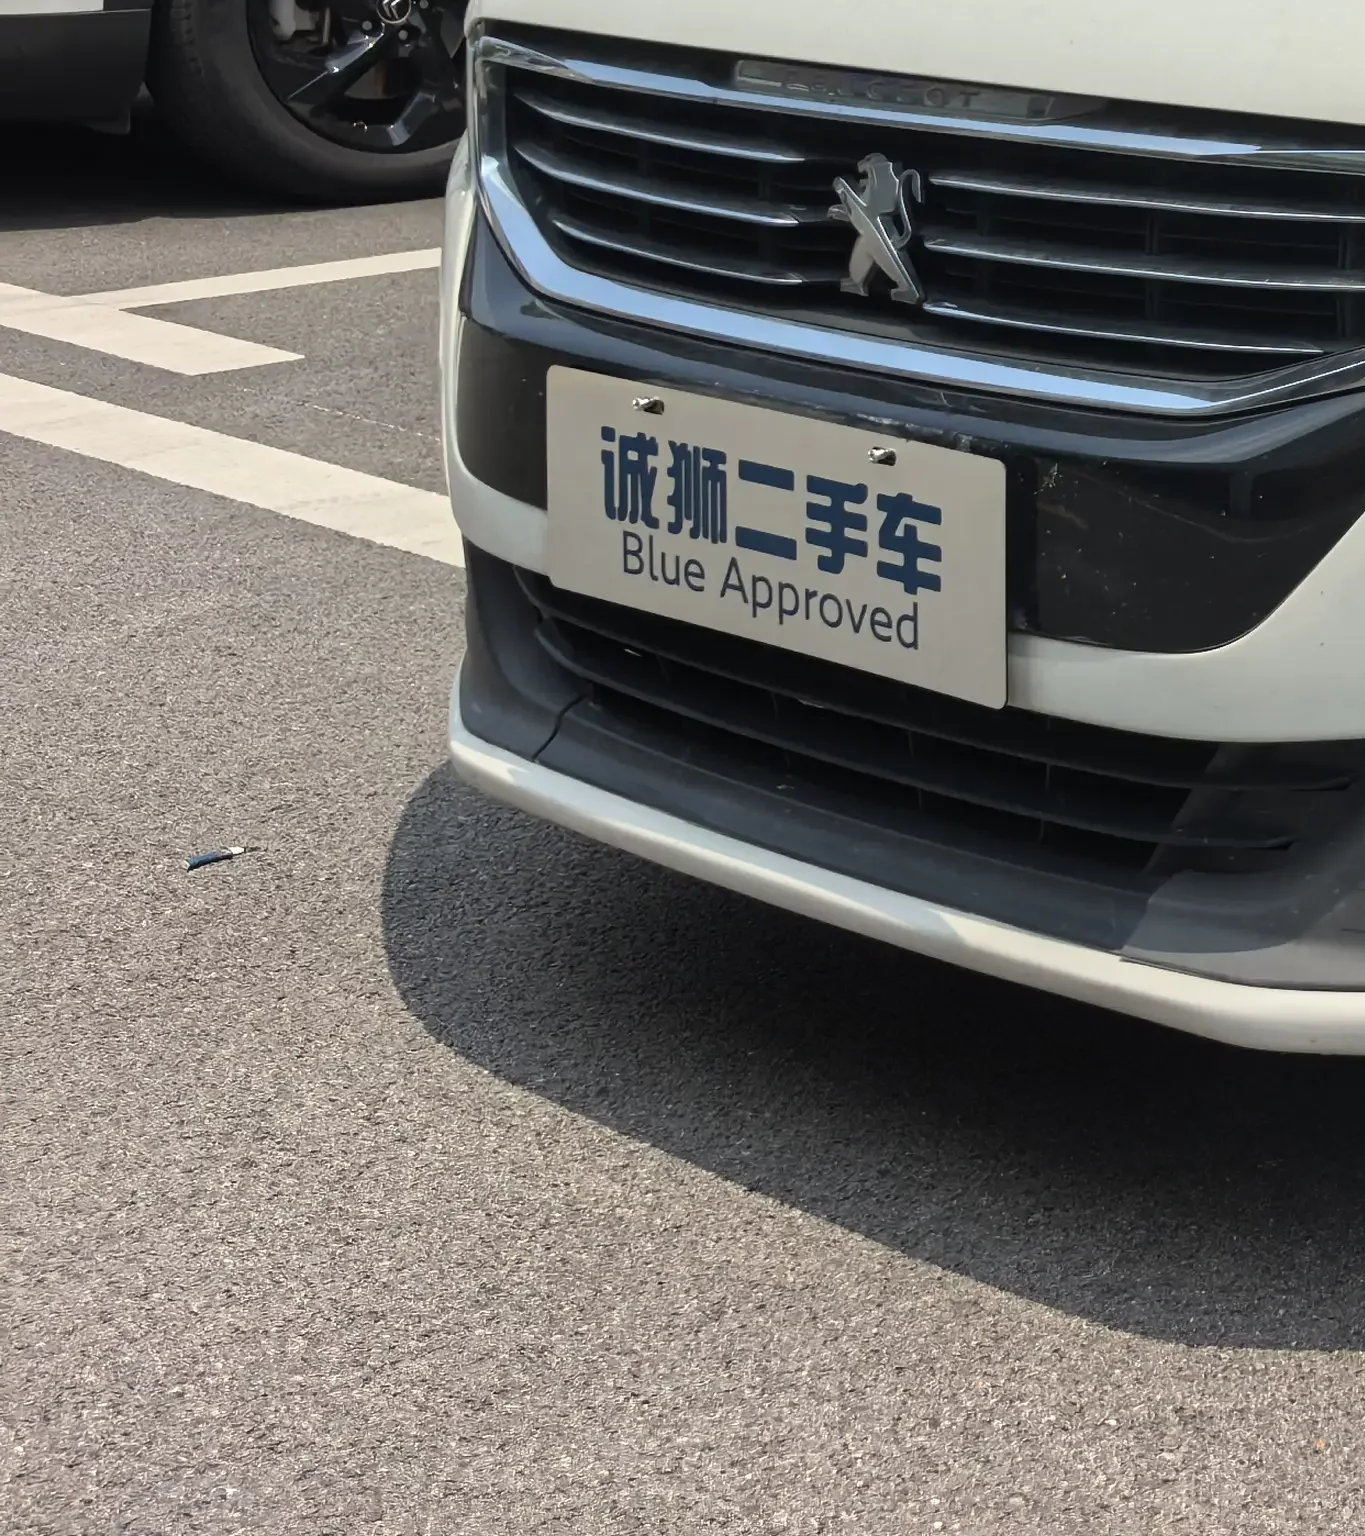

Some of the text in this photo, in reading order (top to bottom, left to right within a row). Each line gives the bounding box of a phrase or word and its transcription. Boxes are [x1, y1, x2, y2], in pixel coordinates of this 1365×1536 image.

[600, 425, 943, 596] 诚狮二手车
[622, 529, 919, 651] Blue Approved
